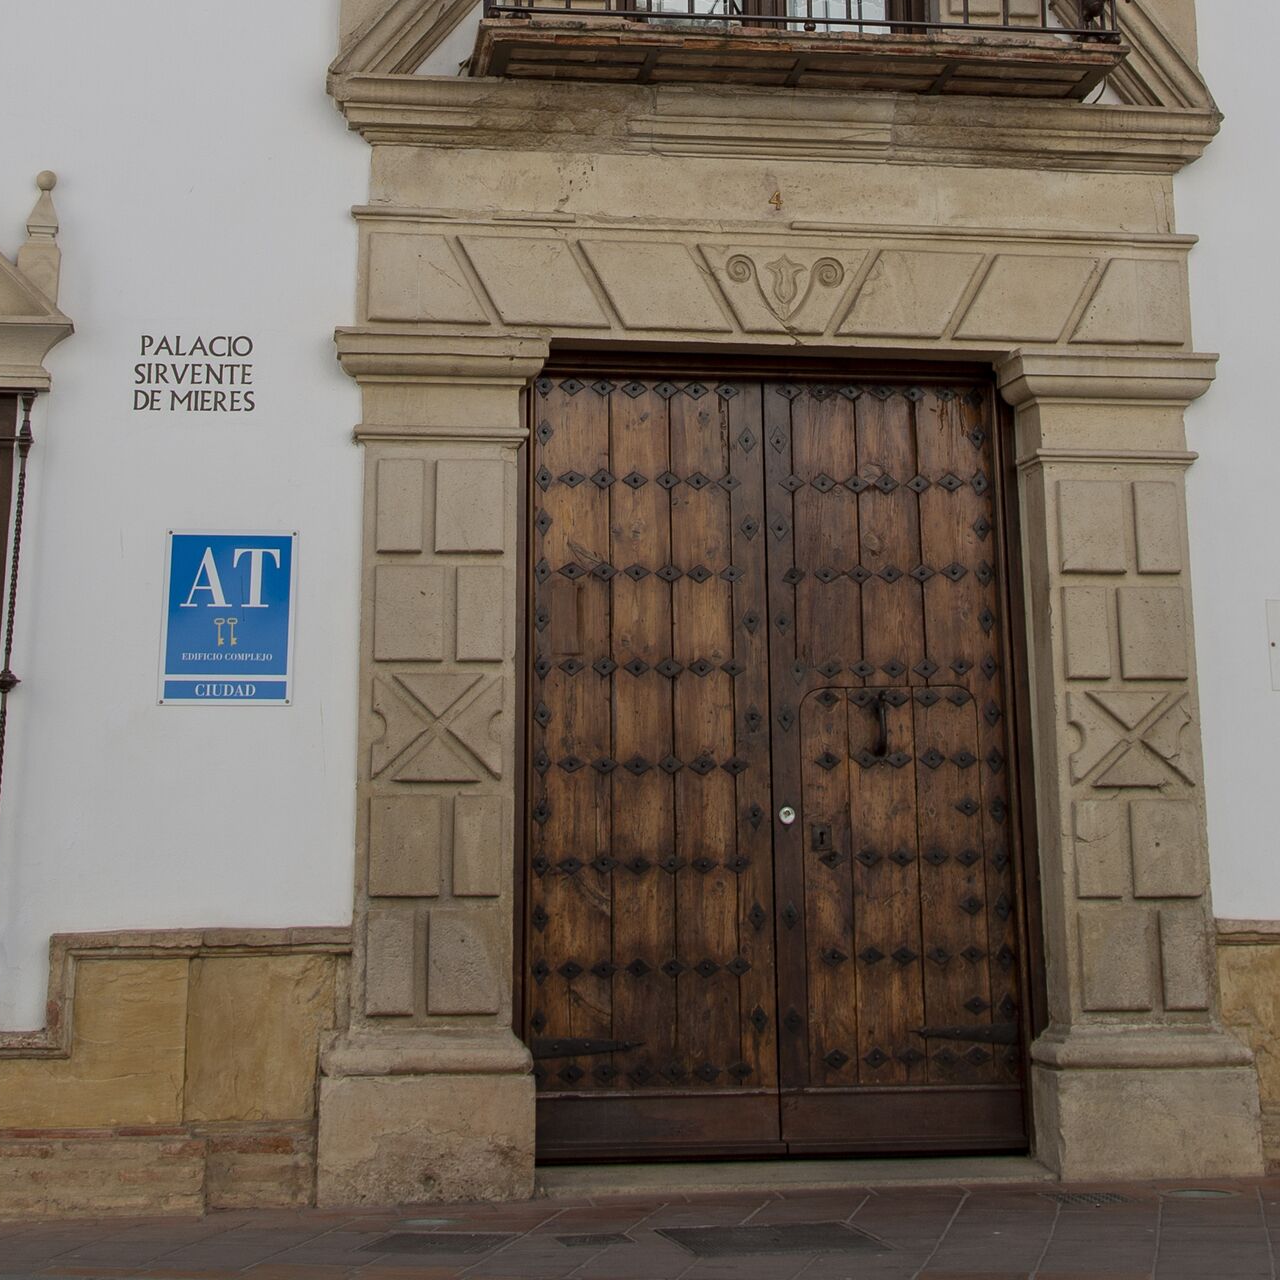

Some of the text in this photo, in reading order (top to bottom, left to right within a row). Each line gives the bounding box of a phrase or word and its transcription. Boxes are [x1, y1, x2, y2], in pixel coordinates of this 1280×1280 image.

[768, 191, 784, 211] 4
[140, 335, 254, 357] PALACIO
[134, 363, 253, 385] SIRVENTE
[133, 389, 256, 412] DE MIERES
[179, 546, 281, 608] AT
[181, 652, 273, 662] EDIFICIO COMPLEJO
[194, 683, 256, 697] CIUDAD
